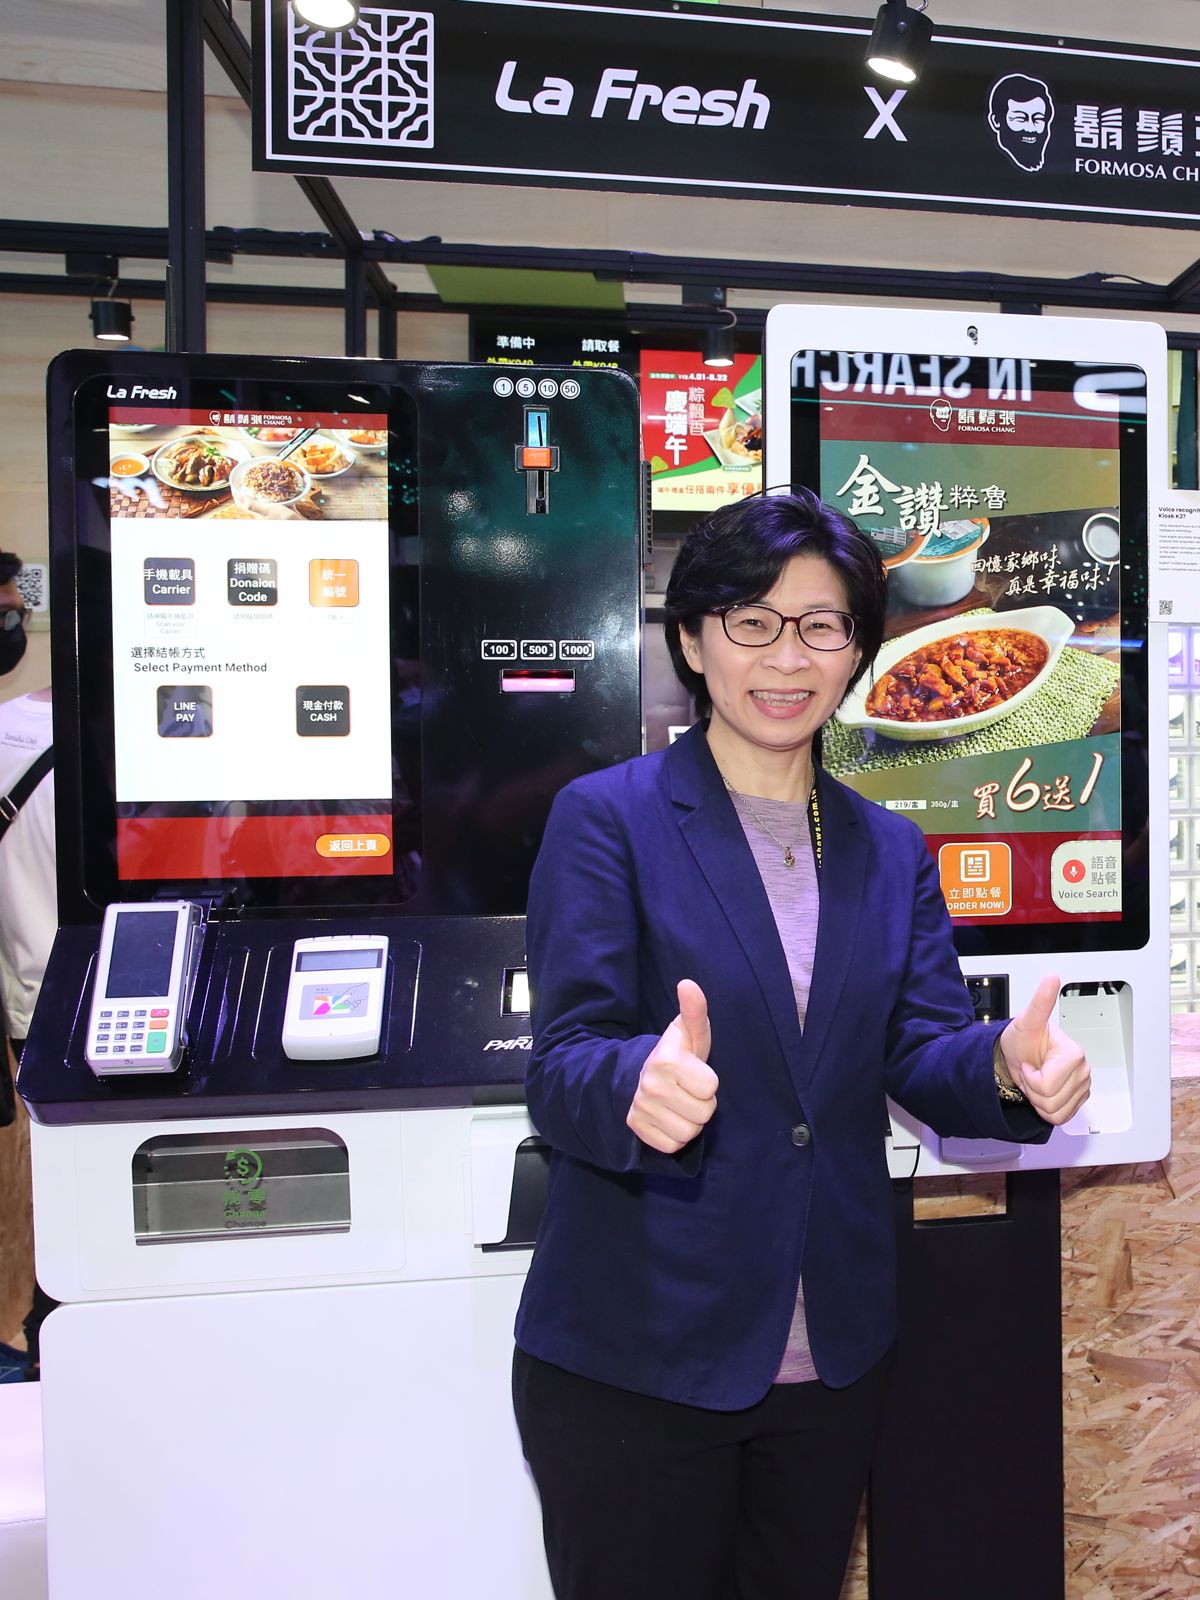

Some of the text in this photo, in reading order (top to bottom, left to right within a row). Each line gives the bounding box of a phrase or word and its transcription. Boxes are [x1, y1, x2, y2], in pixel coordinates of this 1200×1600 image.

[495, 61, 771, 130] La Fresh
[863, 86, 908, 142] X
[1075, 158, 1168, 180] FORMOSA
[496, 335, 535, 350] 準備中
[581, 338, 620, 353] 請取餐
[107, 385, 177, 400] La Fresh
[542, 384, 554, 393] 10
[564, 385, 576, 394] 50
[958, 425, 1016, 434] FORMOSA CHANG
[970, 544, 1061, 573] 回憶家鄉味
[234, 562, 271, 575] 捐贈碼
[144, 569, 193, 581] 手機載具
[230, 577, 276, 588] Donaion
[152, 584, 191, 595] Carrier
[238, 592, 268, 602] Code
[131, 647, 205, 659] 選擇結帳方式
[489, 645, 590, 654] 100 500 1000
[134, 663, 267, 675] Select Payment Method
[174, 702, 196, 711] LINE
[302, 700, 344, 711] 現金付款
[176, 713, 195, 722] PAY
[309, 713, 337, 722] CASH
[329, 839, 377, 852] 返回上頁
[1091, 856, 1117, 870] 語音
[1091, 871, 1117, 885] 點餐
[948, 887, 1002, 900] 立即點餐
[1058, 889, 1118, 899] Voice Search
[946, 901, 1005, 911] ORDER NOW!
